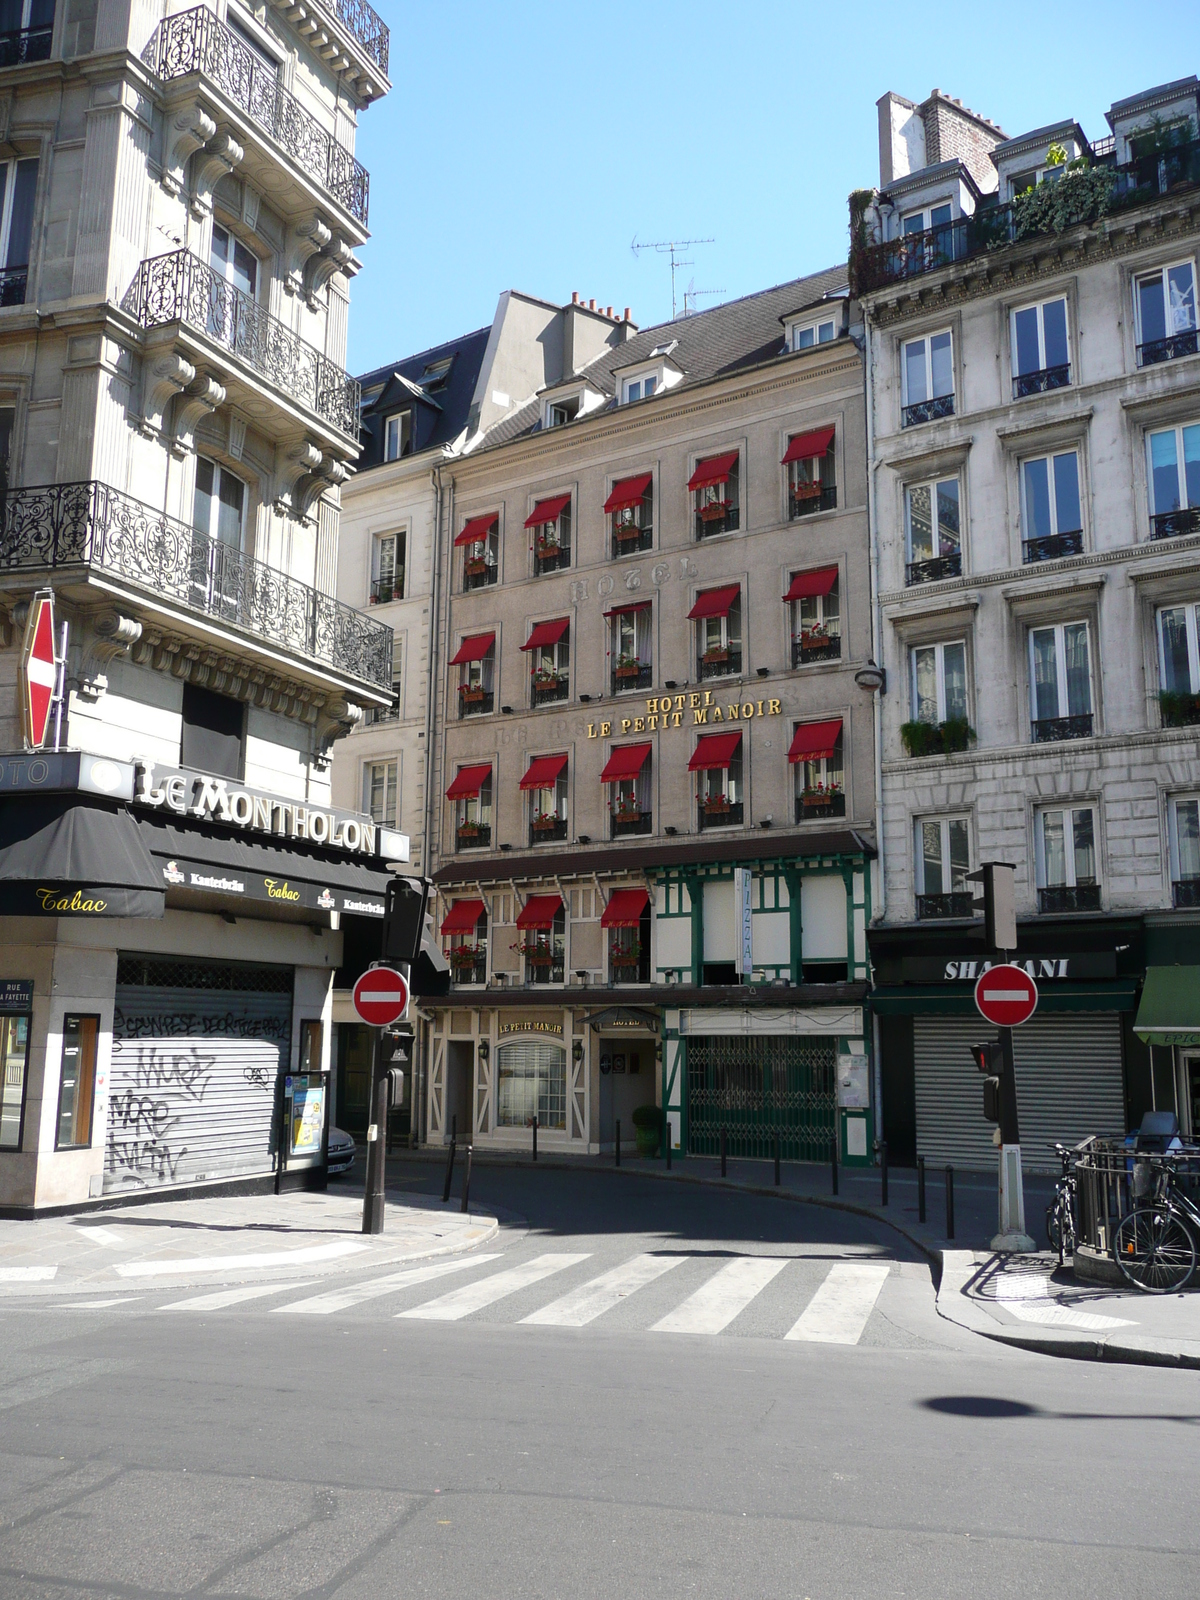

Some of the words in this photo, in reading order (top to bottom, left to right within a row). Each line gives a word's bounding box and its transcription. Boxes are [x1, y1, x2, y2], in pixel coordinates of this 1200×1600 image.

[646, 691, 715, 714] HOTEL
[587, 721, 611, 738] LE
[621, 711, 683, 734] PETIT
[693, 698, 782, 725] MANOIR
[0, 760, 49, 785] TO
[36, 888, 107, 912] Tabac
[264, 879, 300, 901] Tabac
[743, 872, 752, 959] PIZZA
[944, 959, 1069, 980] SHAANI
[500, 1025, 509, 1033] LE
[510, 1022, 532, 1031] PETIT
[533, 1022, 562, 1034] MANOIR
